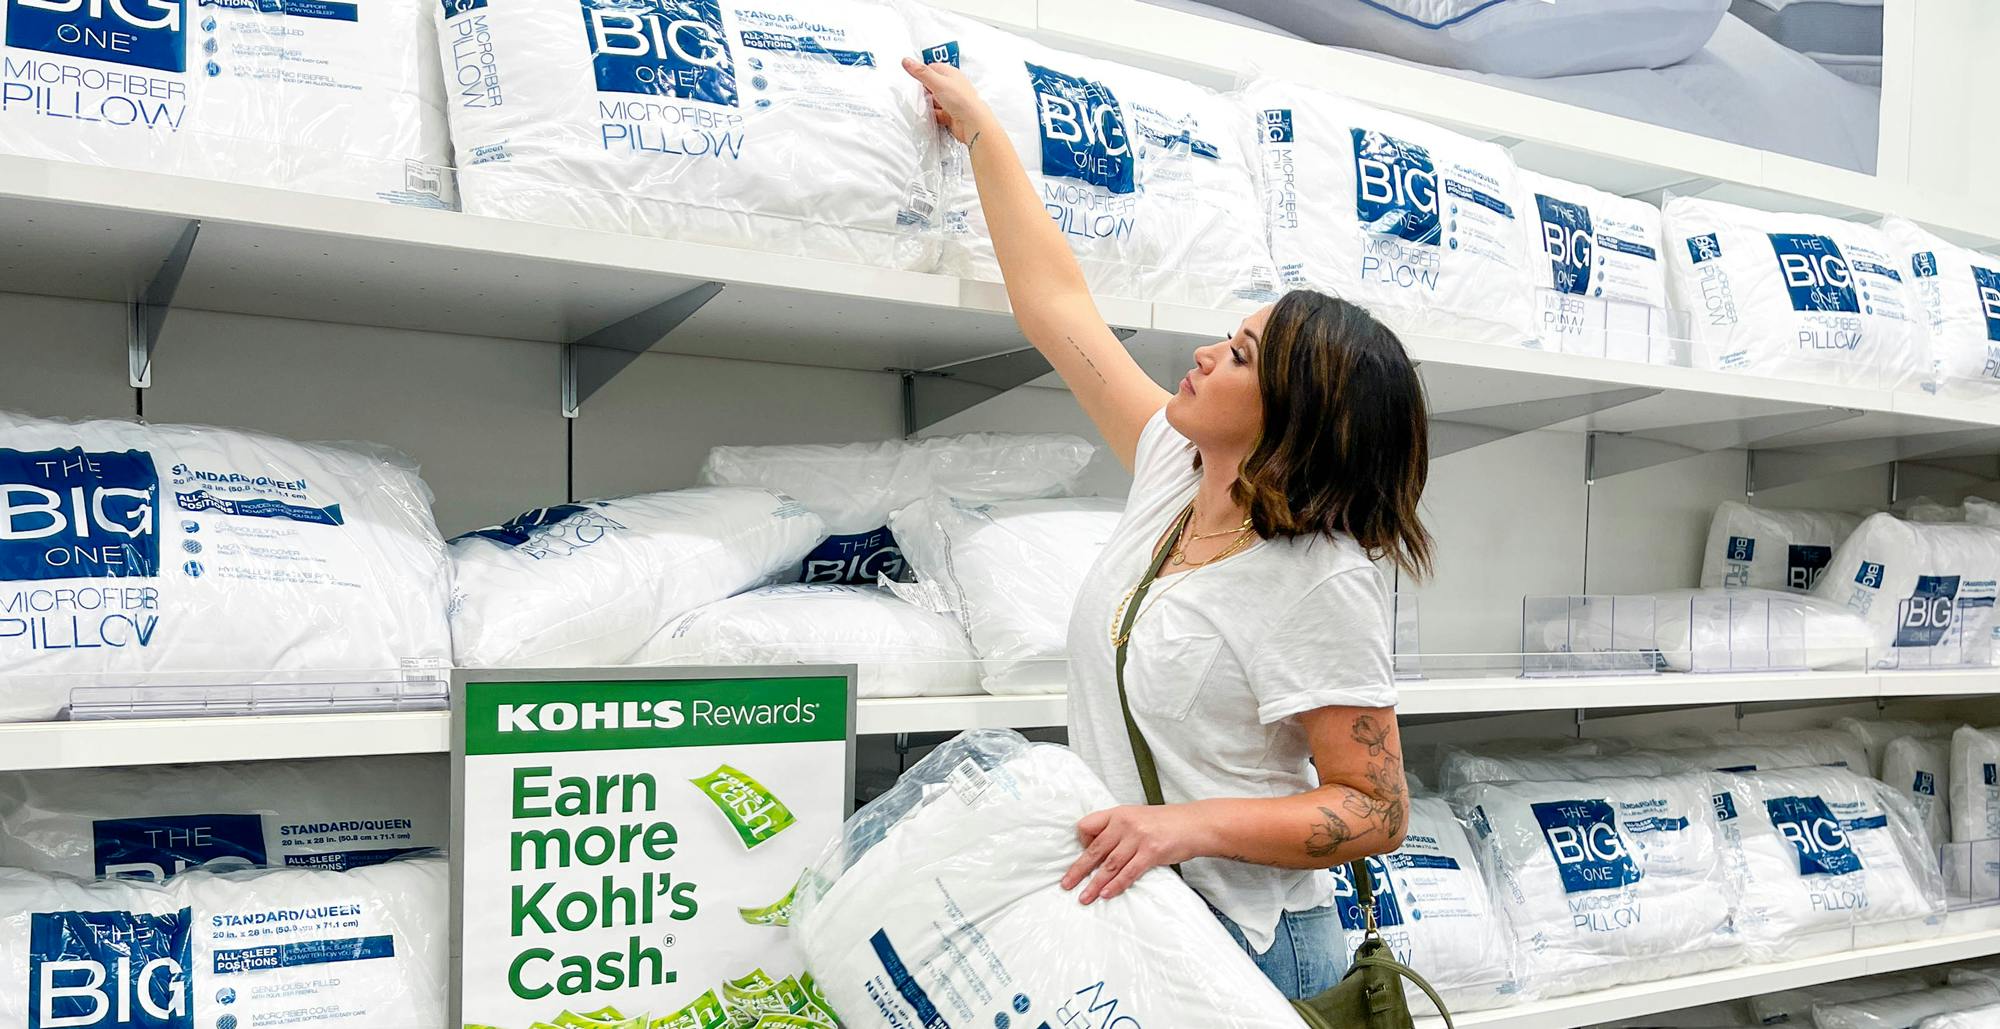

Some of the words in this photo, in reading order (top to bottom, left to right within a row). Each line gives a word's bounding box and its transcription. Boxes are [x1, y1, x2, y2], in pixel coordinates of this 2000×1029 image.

[590, 8, 729, 69] BIG
[450, 19, 487, 108] PILLOW
[473, 15, 503, 107] MICROFIBER
[5, 57, 186, 100] MICROFIBER
[3, 82, 186, 132] PILLOW
[1040, 92, 1131, 157] BIG
[1267, 110, 1284, 142] BIG
[602, 124, 744, 160] PILLOW
[1074, 150, 1108, 175] ONE
[1358, 158, 1438, 215] BIG
[1045, 204, 1134, 240] PILLOW
[1543, 222, 1591, 268] BIG
[1791, 238, 1822, 250] THE
[1361, 256, 1439, 291] PLLOW
[1780, 254, 1853, 288] BIG
[36, 455, 103, 479] THE
[0, 484, 153, 539] BIG
[180, 499, 234, 515] POSITIONS
[45, 545, 124, 566] ONE
[840, 534, 881, 553] THE
[1735, 538, 1748, 560] BIG
[805, 546, 903, 583] BIG
[1862, 564, 1879, 587] BIG
[1929, 582, 1948, 593] THE
[1905, 596, 1951, 628] BIG
[498, 699, 685, 732] KOHL'S
[512, 765, 656, 819] Earn
[1713, 795, 1728, 820] BIG
[281, 819, 412, 836] STANDARD/QUEEN
[1557, 806, 1592, 818] THE
[144, 827, 213, 849] THE
[282, 838, 293, 846] 20
[339, 833, 358, 843] (50.8
[380, 832, 395, 840] 71.1
[397, 832, 411, 840] cm)
[510, 820, 678, 871] more
[1547, 822, 1626, 864] BIG
[1777, 818, 1850, 854] BIG
[288, 854, 342, 864] ALL-SLEEP
[1583, 866, 1613, 881] ONE
[1329, 854, 1391, 897] BG
[212, 904, 361, 927] STANDARD/QUEEN
[510, 871, 698, 937] Kohl's
[262, 926, 273, 935] in.
[343, 919, 359, 929] cm)
[216, 948, 278, 961] ALL-SLEEP
[217, 957, 278, 971] POSITIONS
[40, 956, 186, 1029] BIG
[309, 1005, 340, 1014] COVER
